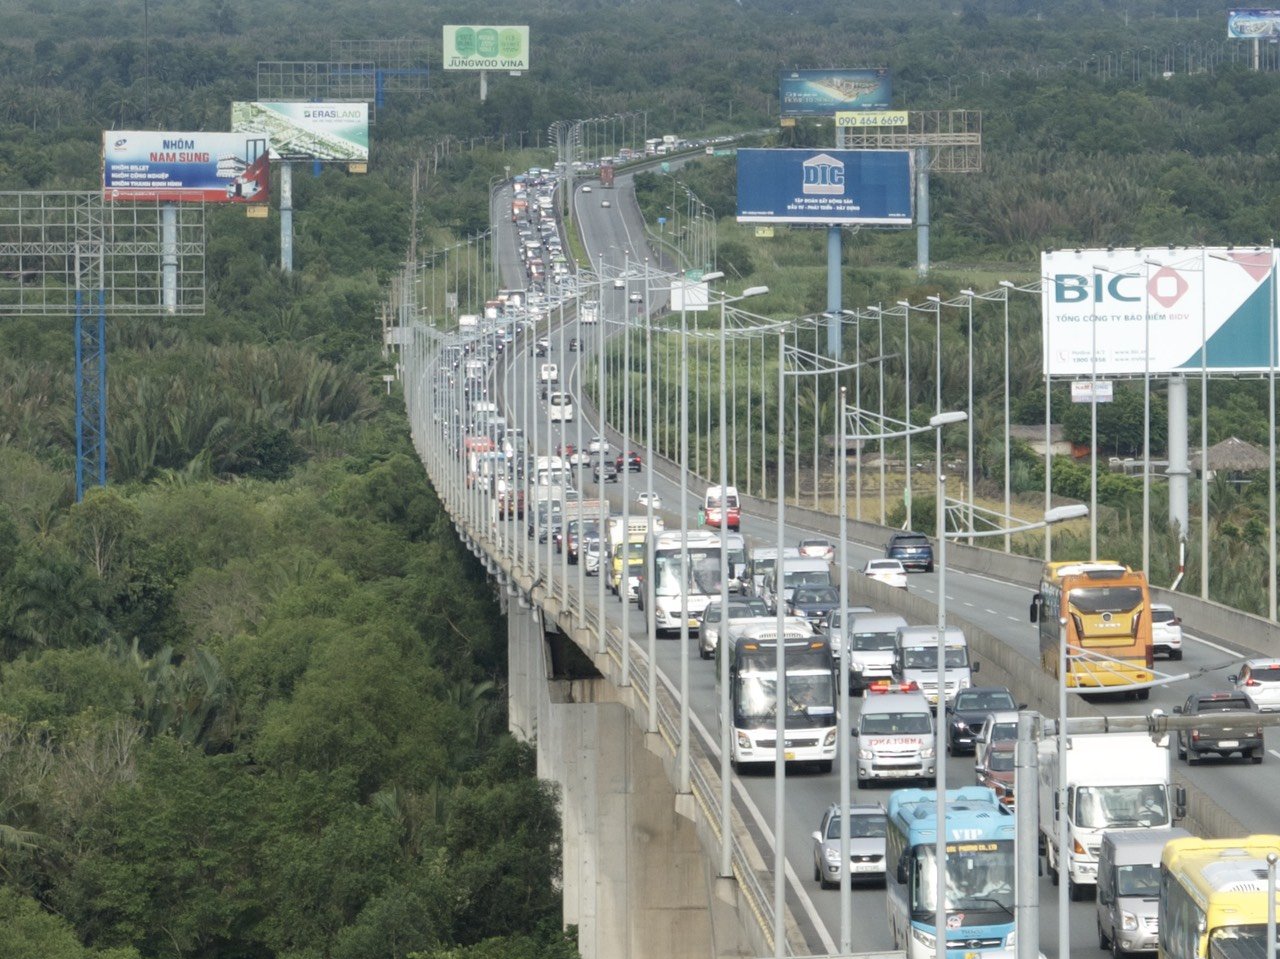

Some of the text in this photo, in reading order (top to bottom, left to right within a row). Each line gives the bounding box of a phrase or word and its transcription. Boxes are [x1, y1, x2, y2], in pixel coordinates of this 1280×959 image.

[312, 110, 361, 119] ERASLAND
[838, 115, 905, 126] 090 464 6699
[162, 138, 195, 150] NHÔM
[150, 152, 210, 163] NAM SUNG
[803, 165, 845, 185] DIC
[1055, 273, 1141, 303] BIC
[1169, 313, 1190, 321] BIDV
[952, 829, 983, 841] VIP
